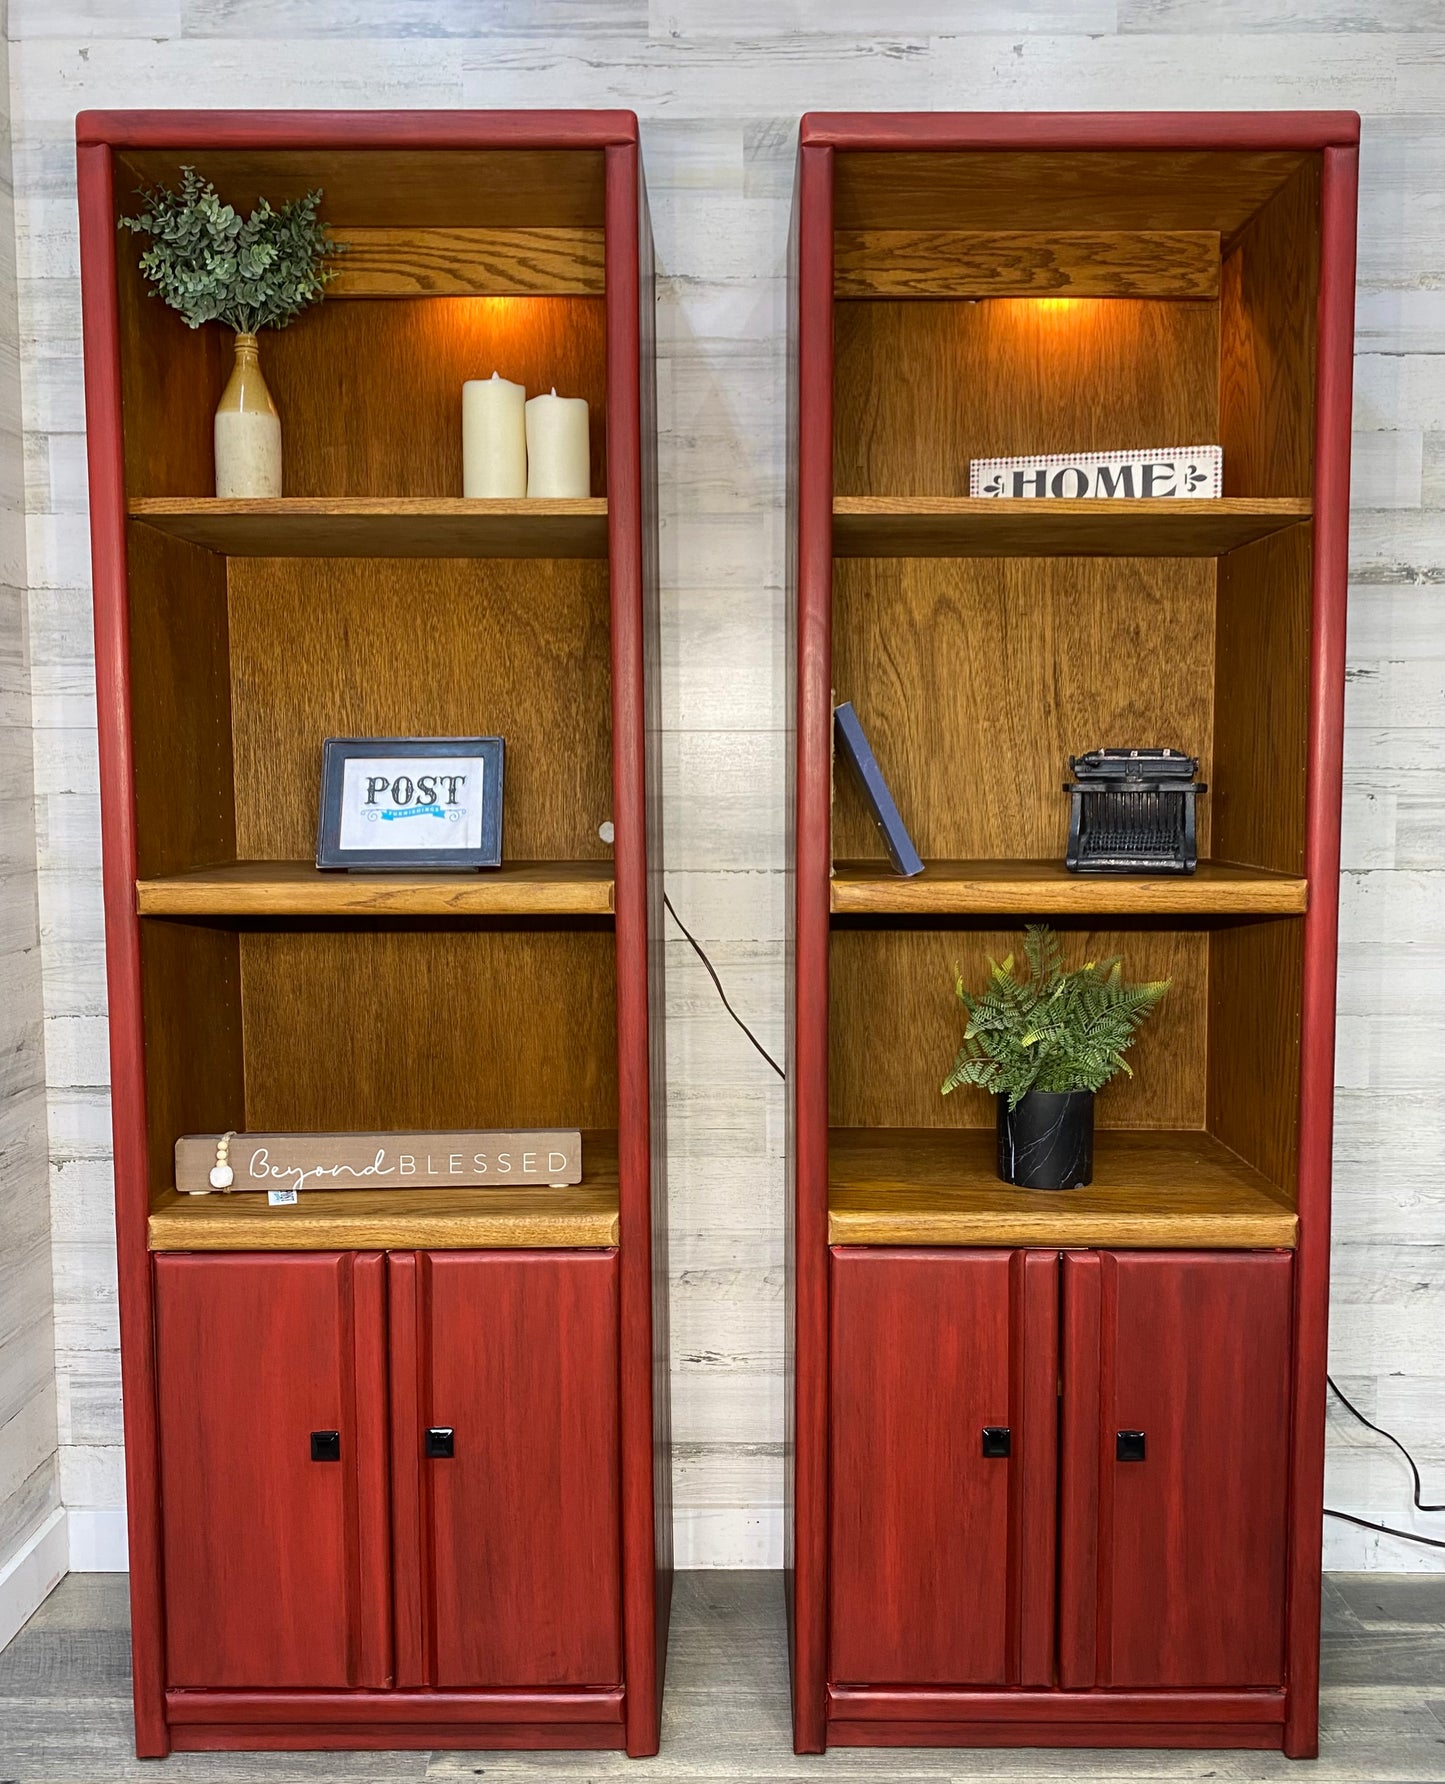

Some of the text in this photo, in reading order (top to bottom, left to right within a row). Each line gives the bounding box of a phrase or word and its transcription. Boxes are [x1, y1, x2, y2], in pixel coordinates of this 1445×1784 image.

[1013, 463, 1178, 498] HOME
[364, 775, 466, 805] POST
[249, 1148, 567, 1190] Beyond BLESSED
